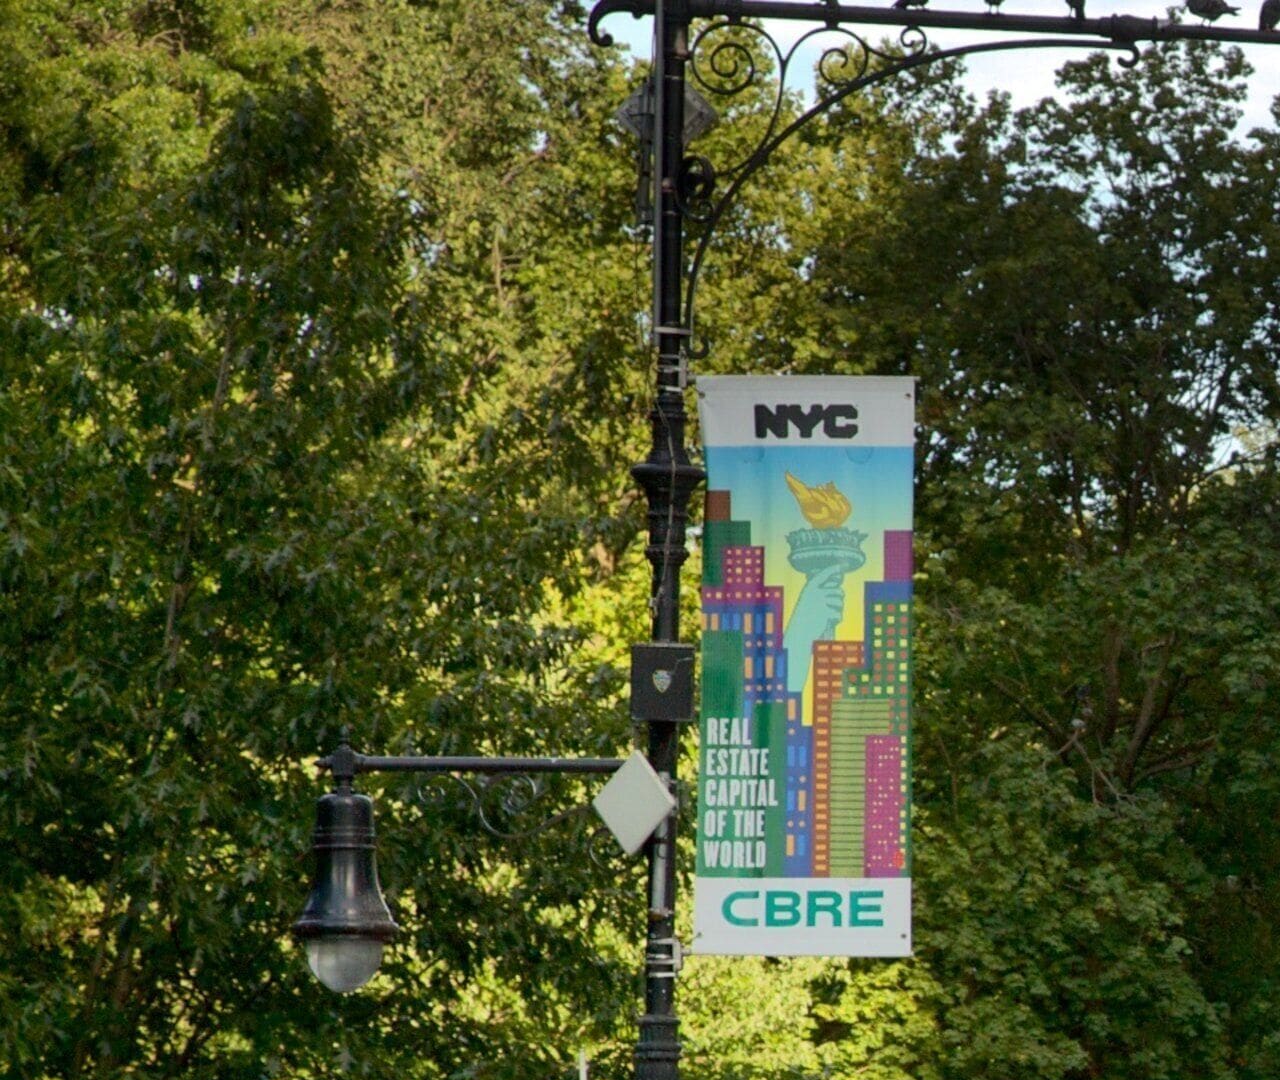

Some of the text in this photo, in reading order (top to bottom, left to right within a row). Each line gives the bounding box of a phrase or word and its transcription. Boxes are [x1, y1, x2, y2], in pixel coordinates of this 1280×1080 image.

[754, 403, 859, 440] NYC
[706, 717, 752, 747] REAL
[705, 747, 770, 777] ESTATE
[704, 777, 779, 808] CAPITAL
[703, 810, 766, 839] OF THE
[703, 839, 767, 869] WORLD
[721, 890, 885, 928] CBRE
